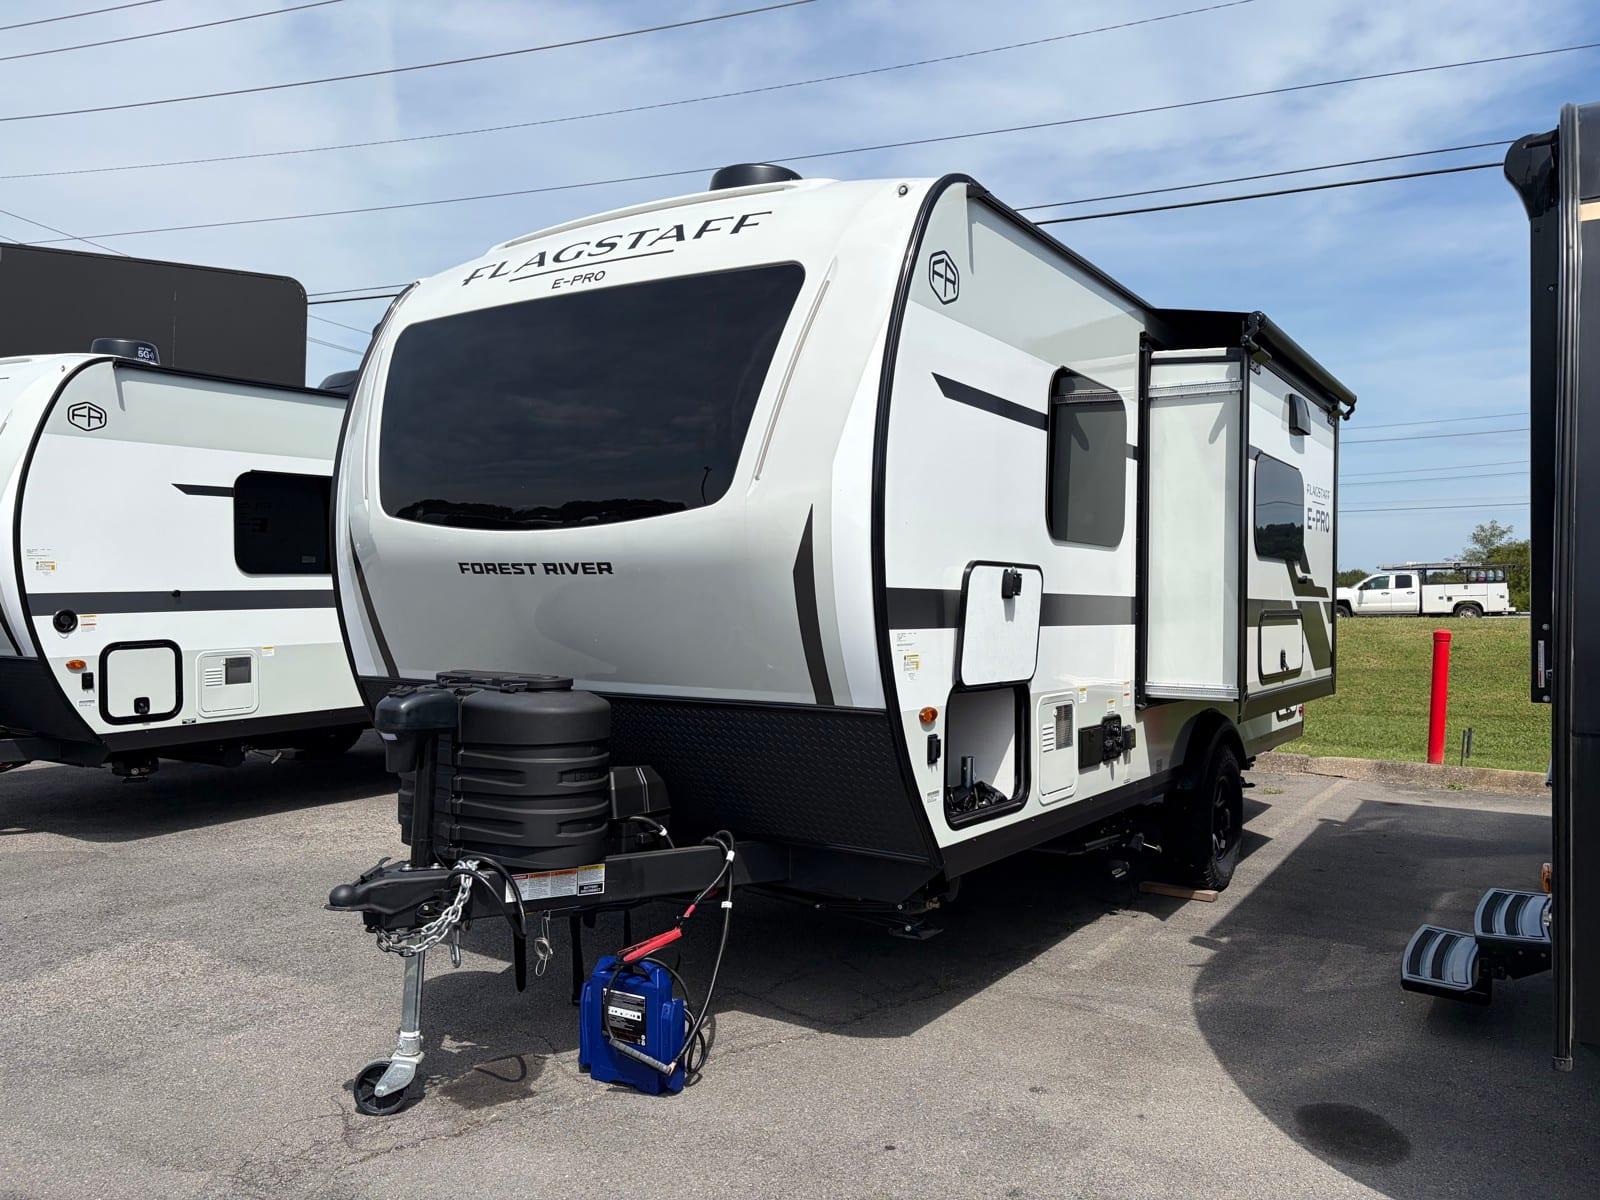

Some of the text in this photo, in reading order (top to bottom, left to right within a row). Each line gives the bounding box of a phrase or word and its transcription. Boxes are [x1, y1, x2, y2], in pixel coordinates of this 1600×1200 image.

[461, 211, 772, 286] FLAGSTAFF
[552, 270, 606, 290] E-PRO
[1307, 507, 1330, 533] E-PRO
[457, 561, 614, 575] FOREST RIVER
